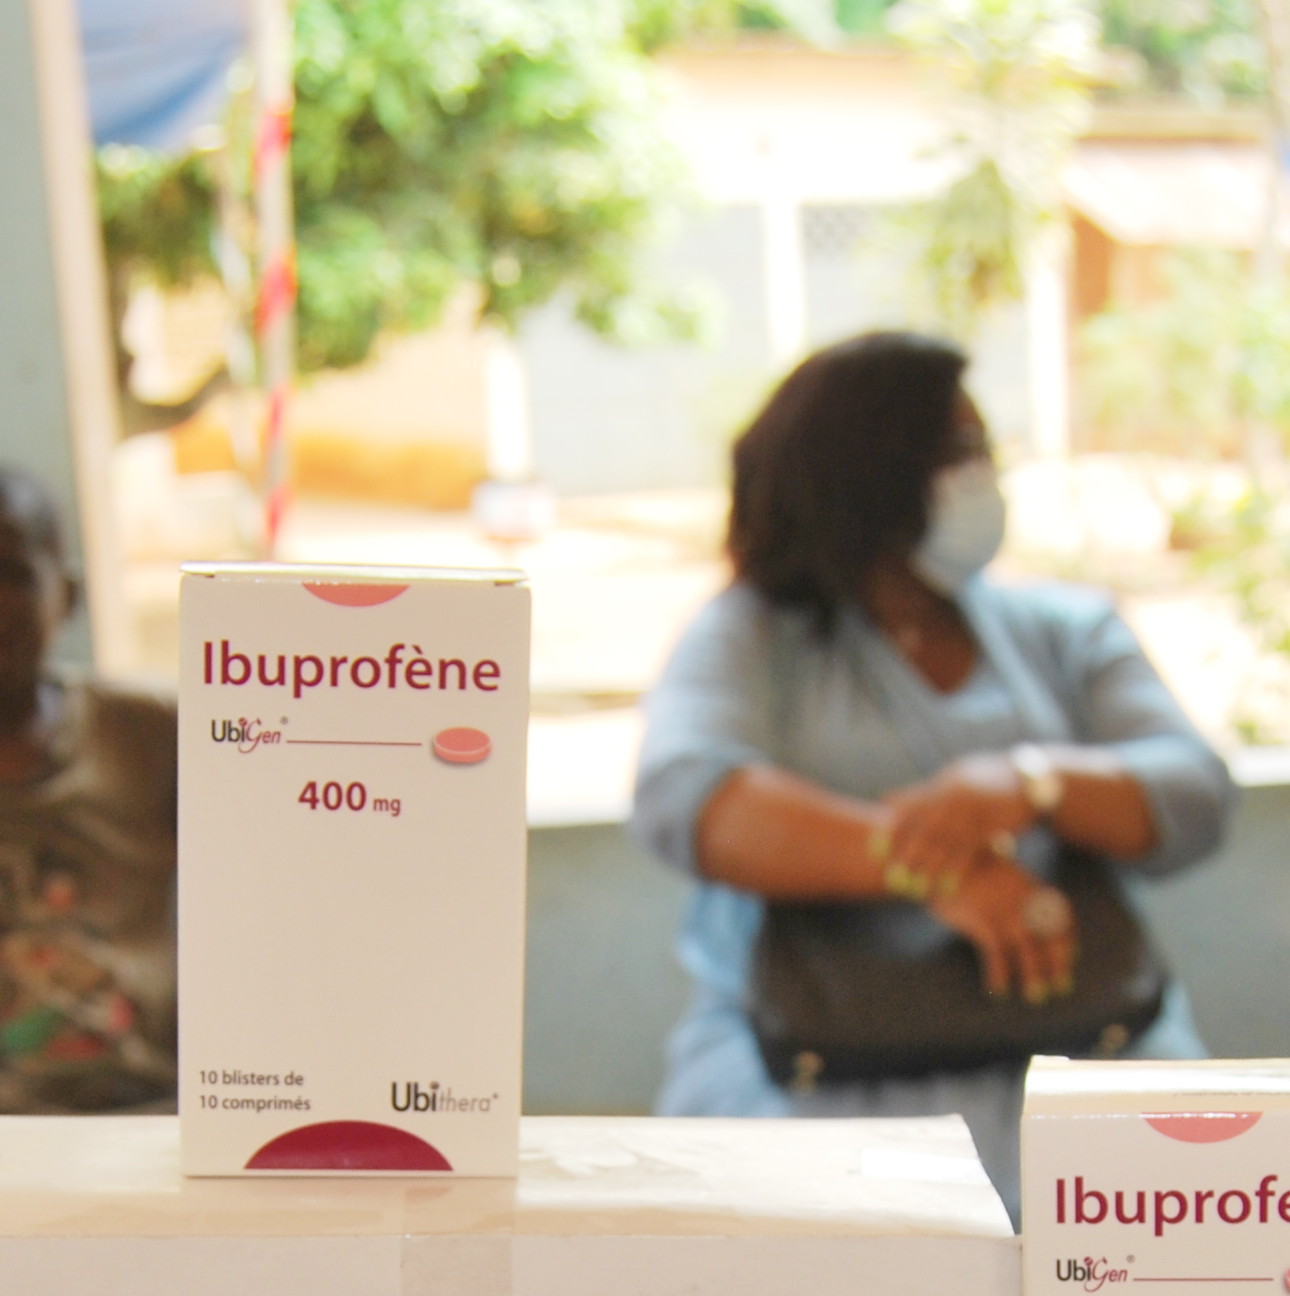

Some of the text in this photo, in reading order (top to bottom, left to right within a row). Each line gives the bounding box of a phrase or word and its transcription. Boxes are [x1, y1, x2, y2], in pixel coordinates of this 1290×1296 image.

[203, 641, 502, 698] Ibuprofène
[298, 781, 401, 817] 400 mg
[199, 1069, 304, 1087] 10 blisters de
[199, 1094, 311, 1115] 10 comprimés
